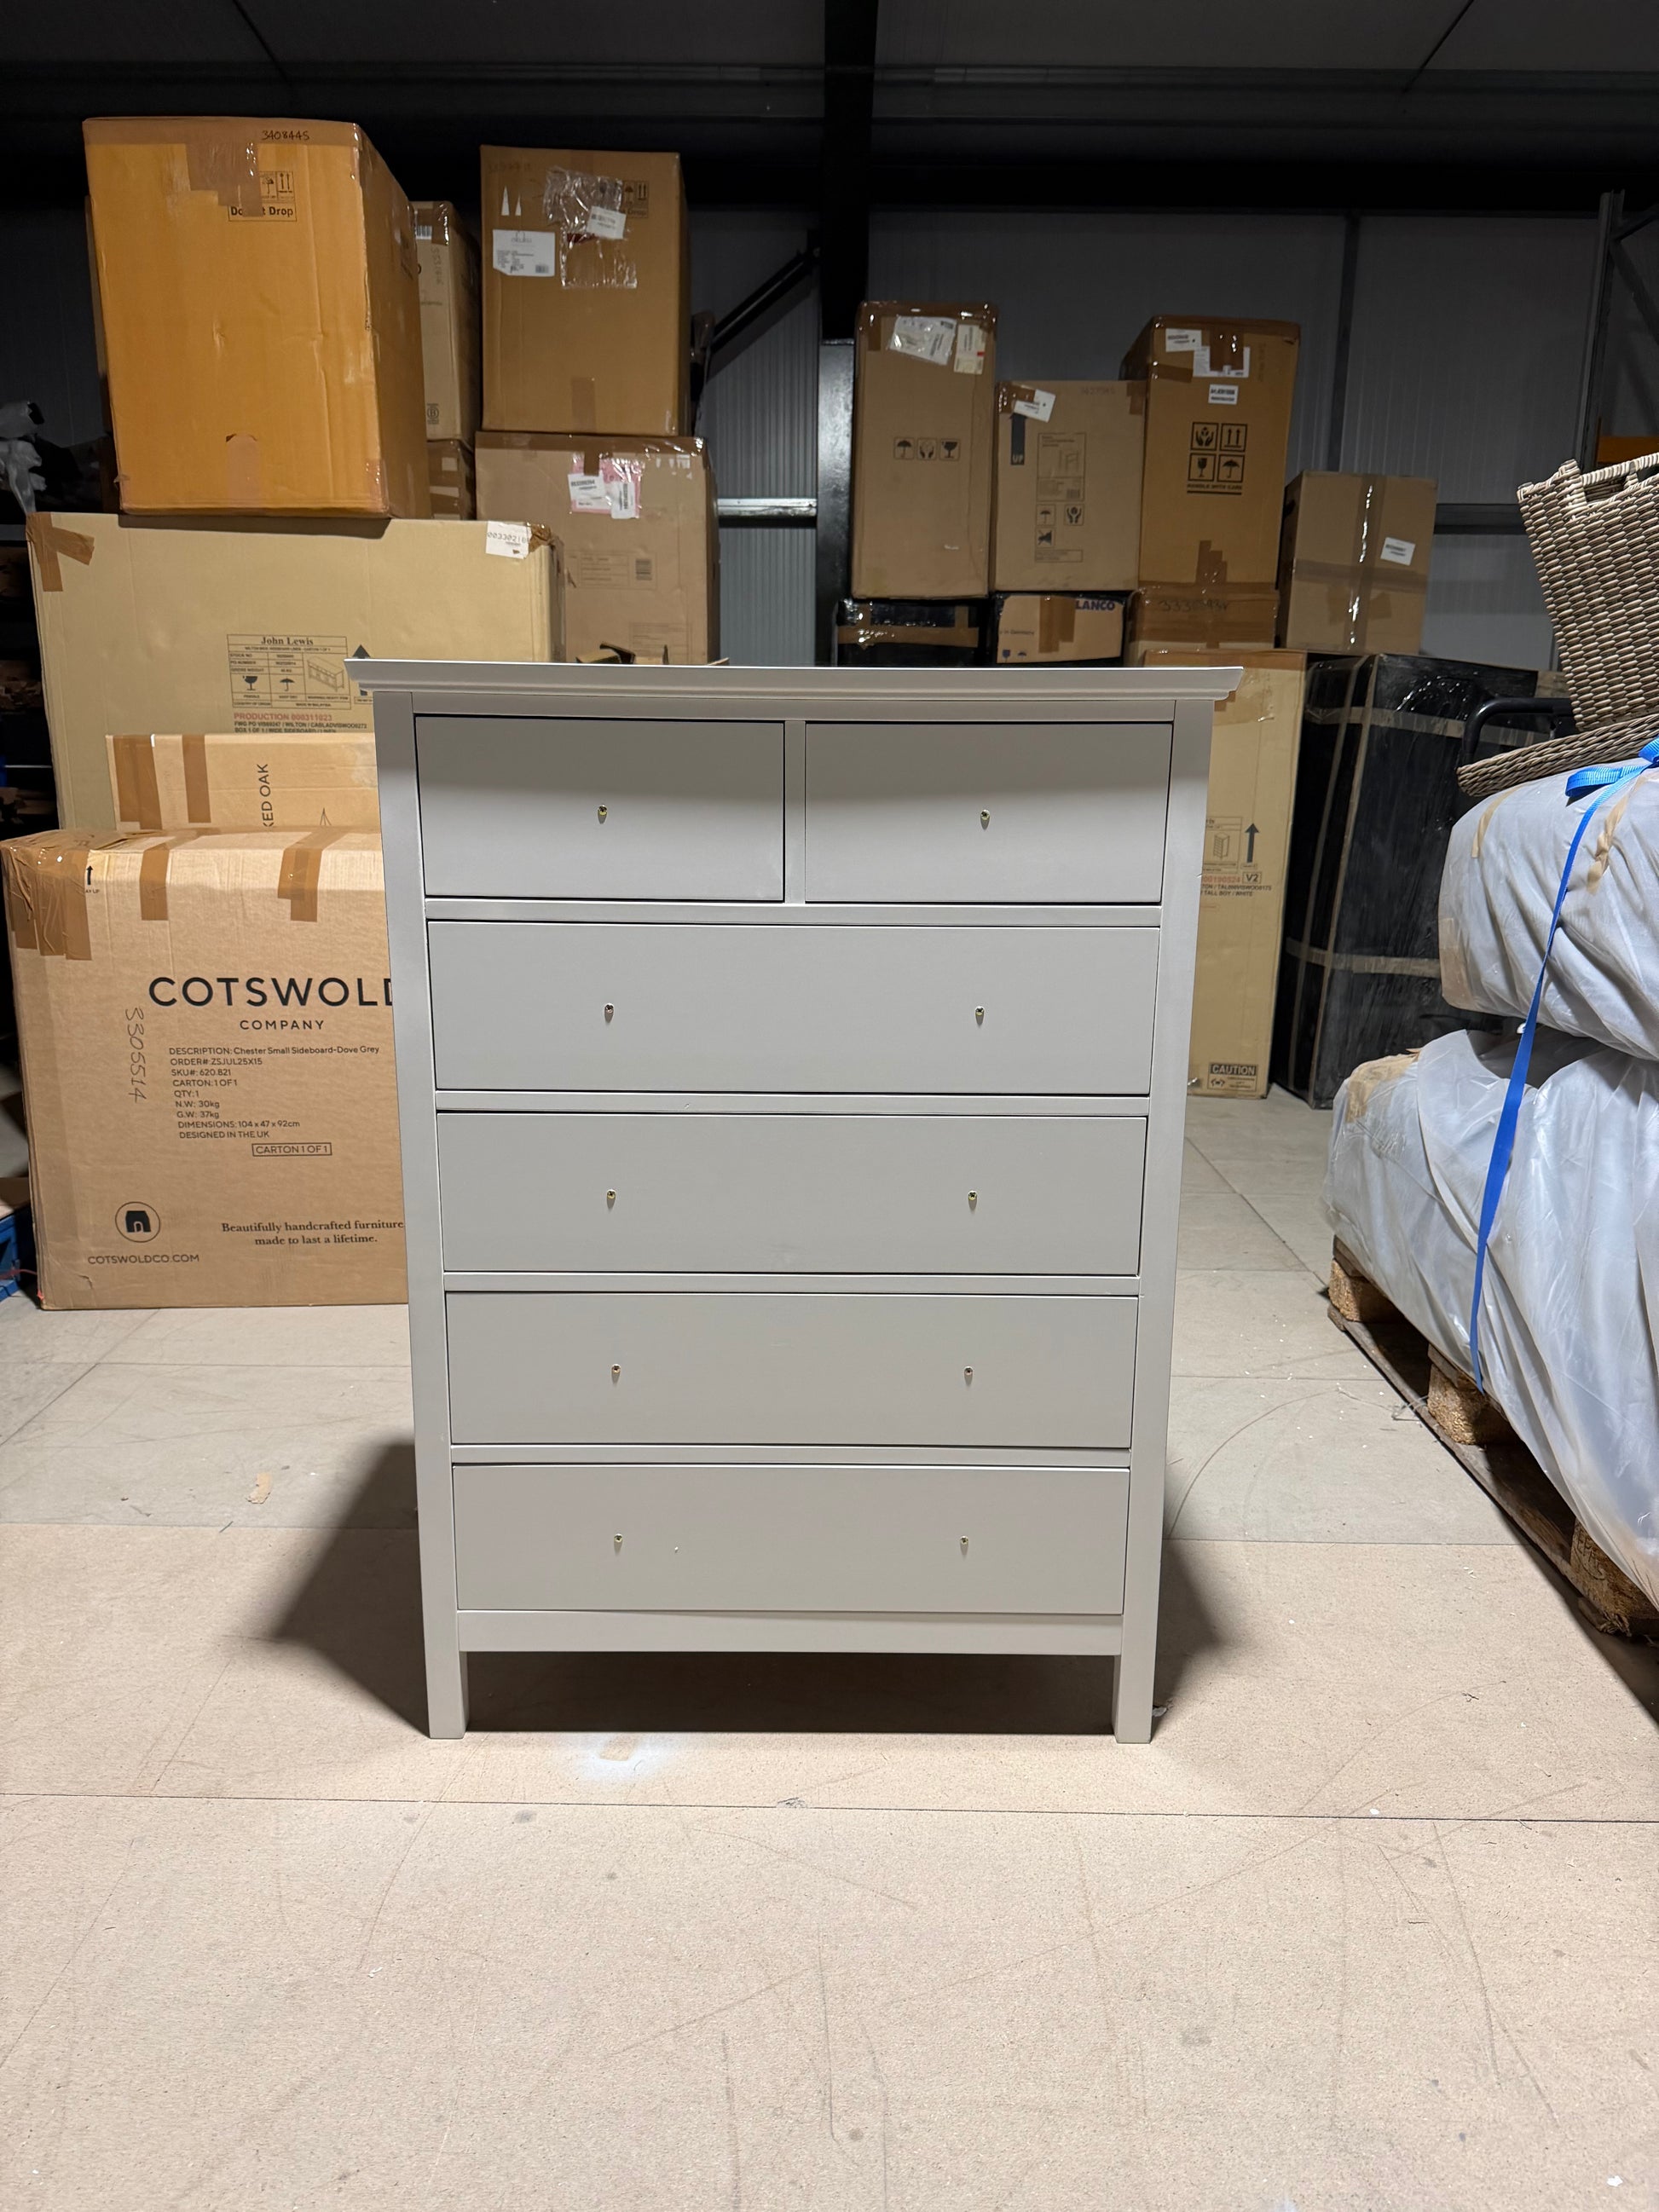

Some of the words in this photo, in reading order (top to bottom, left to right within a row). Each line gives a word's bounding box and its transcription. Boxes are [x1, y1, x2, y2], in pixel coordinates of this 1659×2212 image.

[269, 206, 293, 217] Drop
[1013, 453, 1024, 464] UP
[261, 636, 284, 644] John
[286, 638, 314, 646] Lewis
[257, 764, 271, 797] OAK
[240, 1019, 324, 1031] COMPANY
[125, 1007, 147, 1103] 3305514
[360, 1045, 379, 1054] Grey
[1212, 1064, 1255, 1075] CAUTION
[256, 1146, 298, 1154] CARTON
[222, 1222, 281, 1233] Beautifully
[285, 1221, 351, 1231] handcrafted
[255, 1236, 285, 1245] made
[288, 1236, 298, 1245] to
[302, 1234, 321, 1245] last
[333, 1234, 378, 1243] lifetime.
[88, 1255, 199, 1265] COTSWOLDCO.COM
